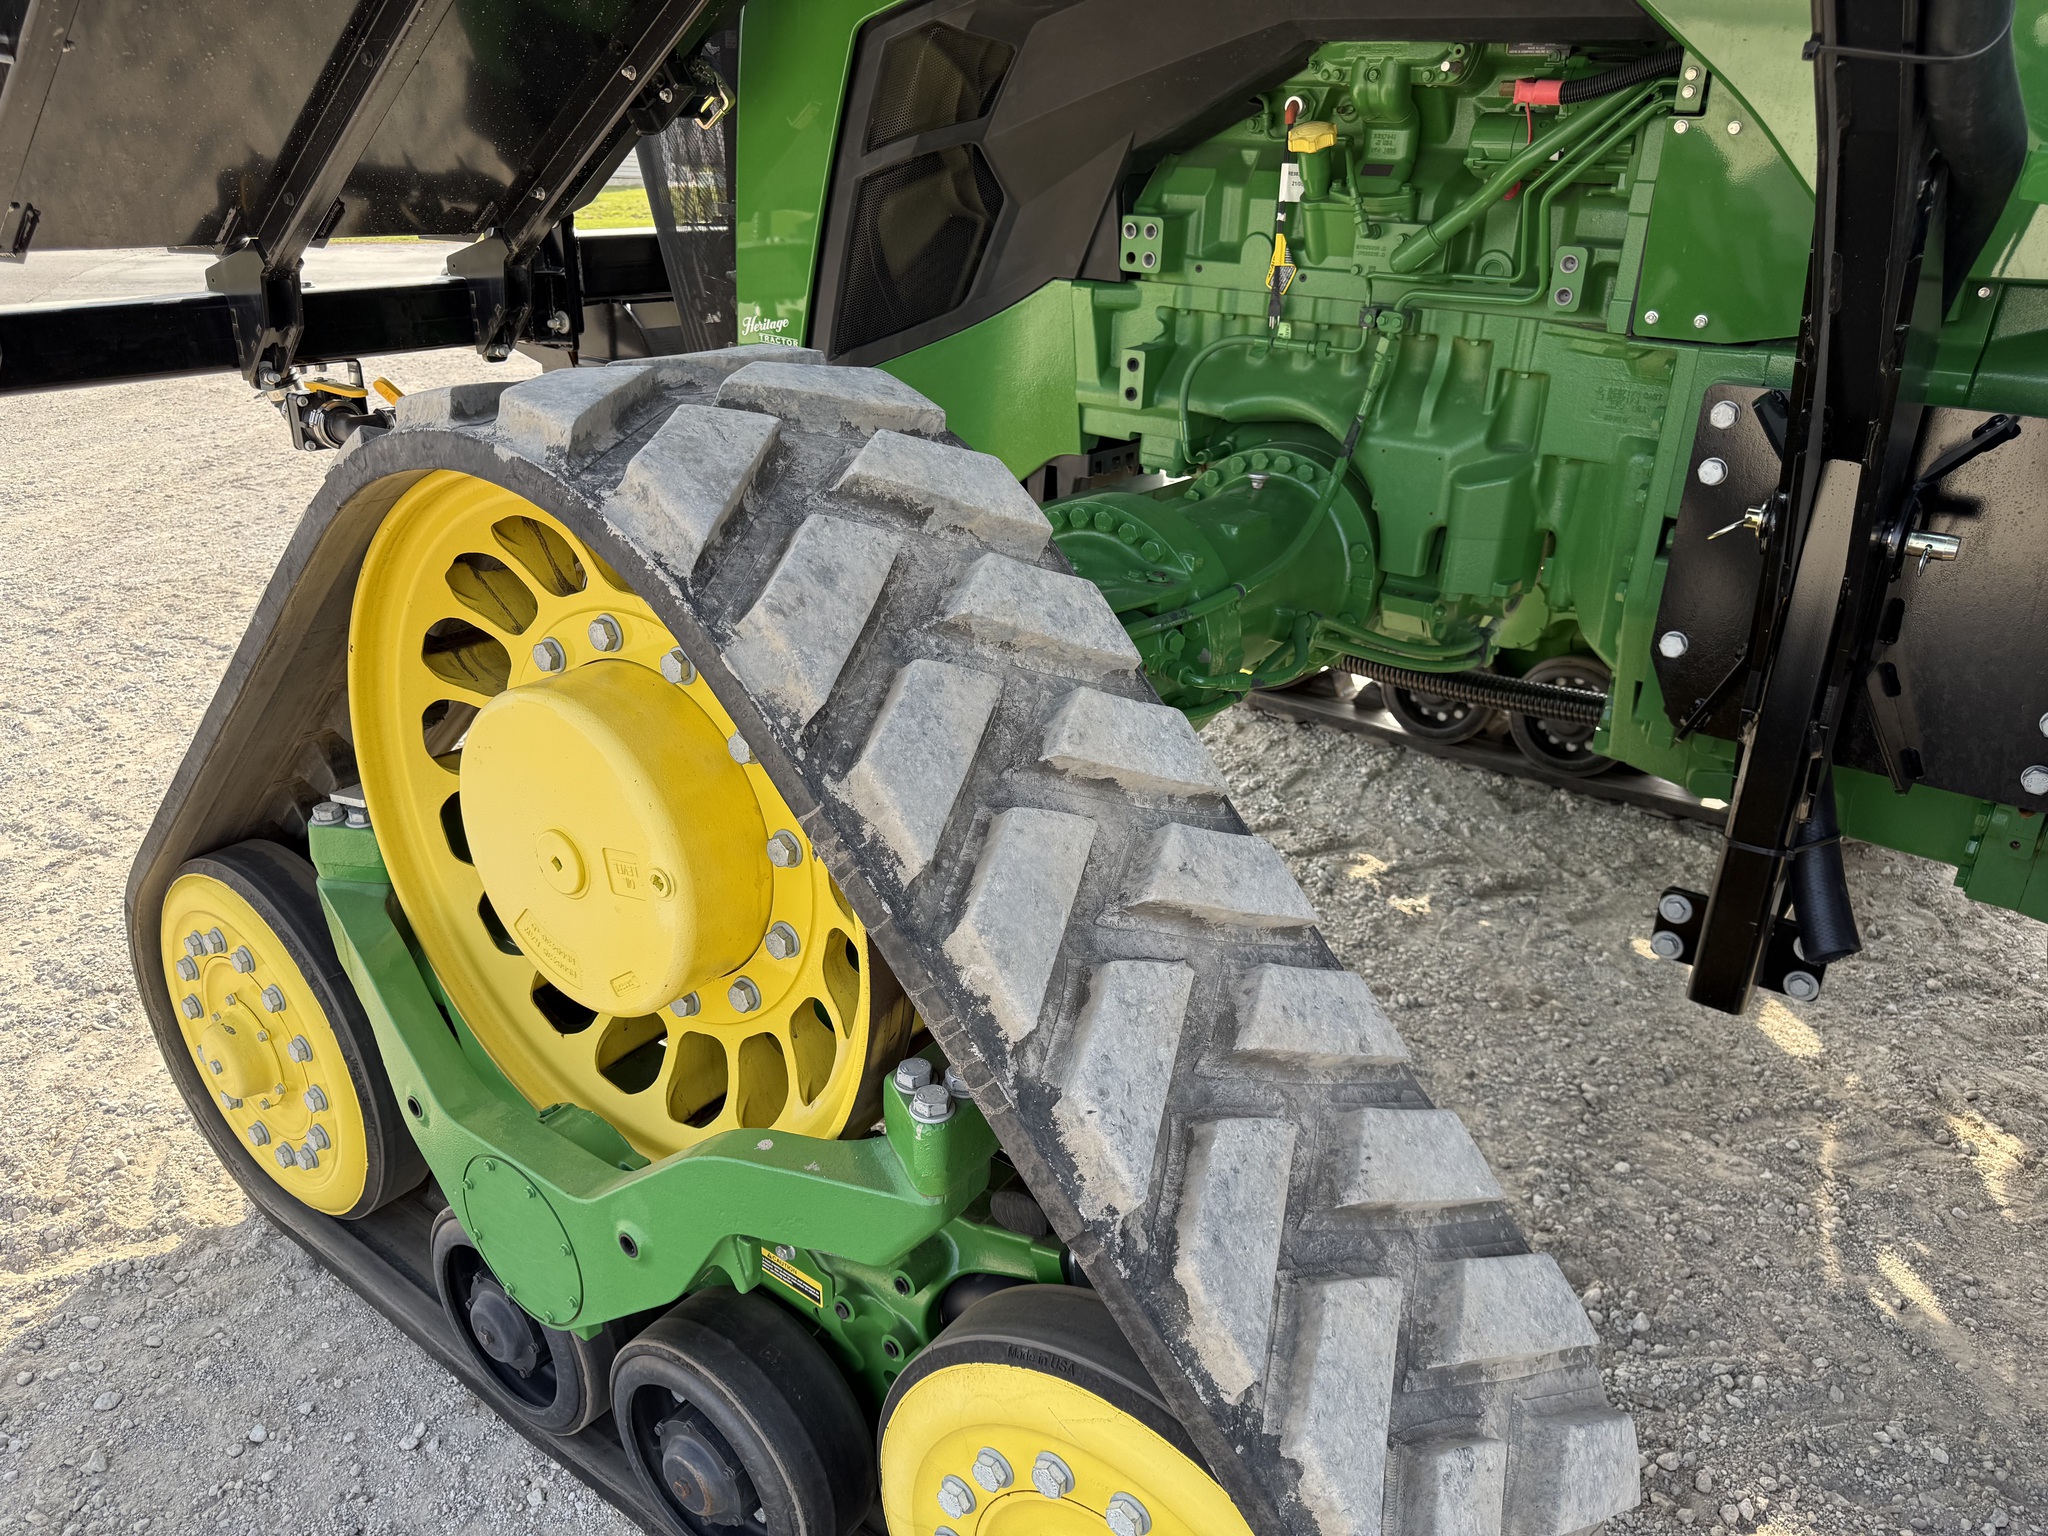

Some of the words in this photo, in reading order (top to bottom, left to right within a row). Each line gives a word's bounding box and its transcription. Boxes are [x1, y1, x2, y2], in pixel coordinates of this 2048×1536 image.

[742, 316, 789, 335] Heritage
[760, 334, 798, 347] TRACTOR
[612, 862, 639, 878] LEVEL
[1007, 1345, 1036, 1362] Made
[1038, 1351, 1048, 1366] in
[1050, 1357, 1075, 1377] USA
